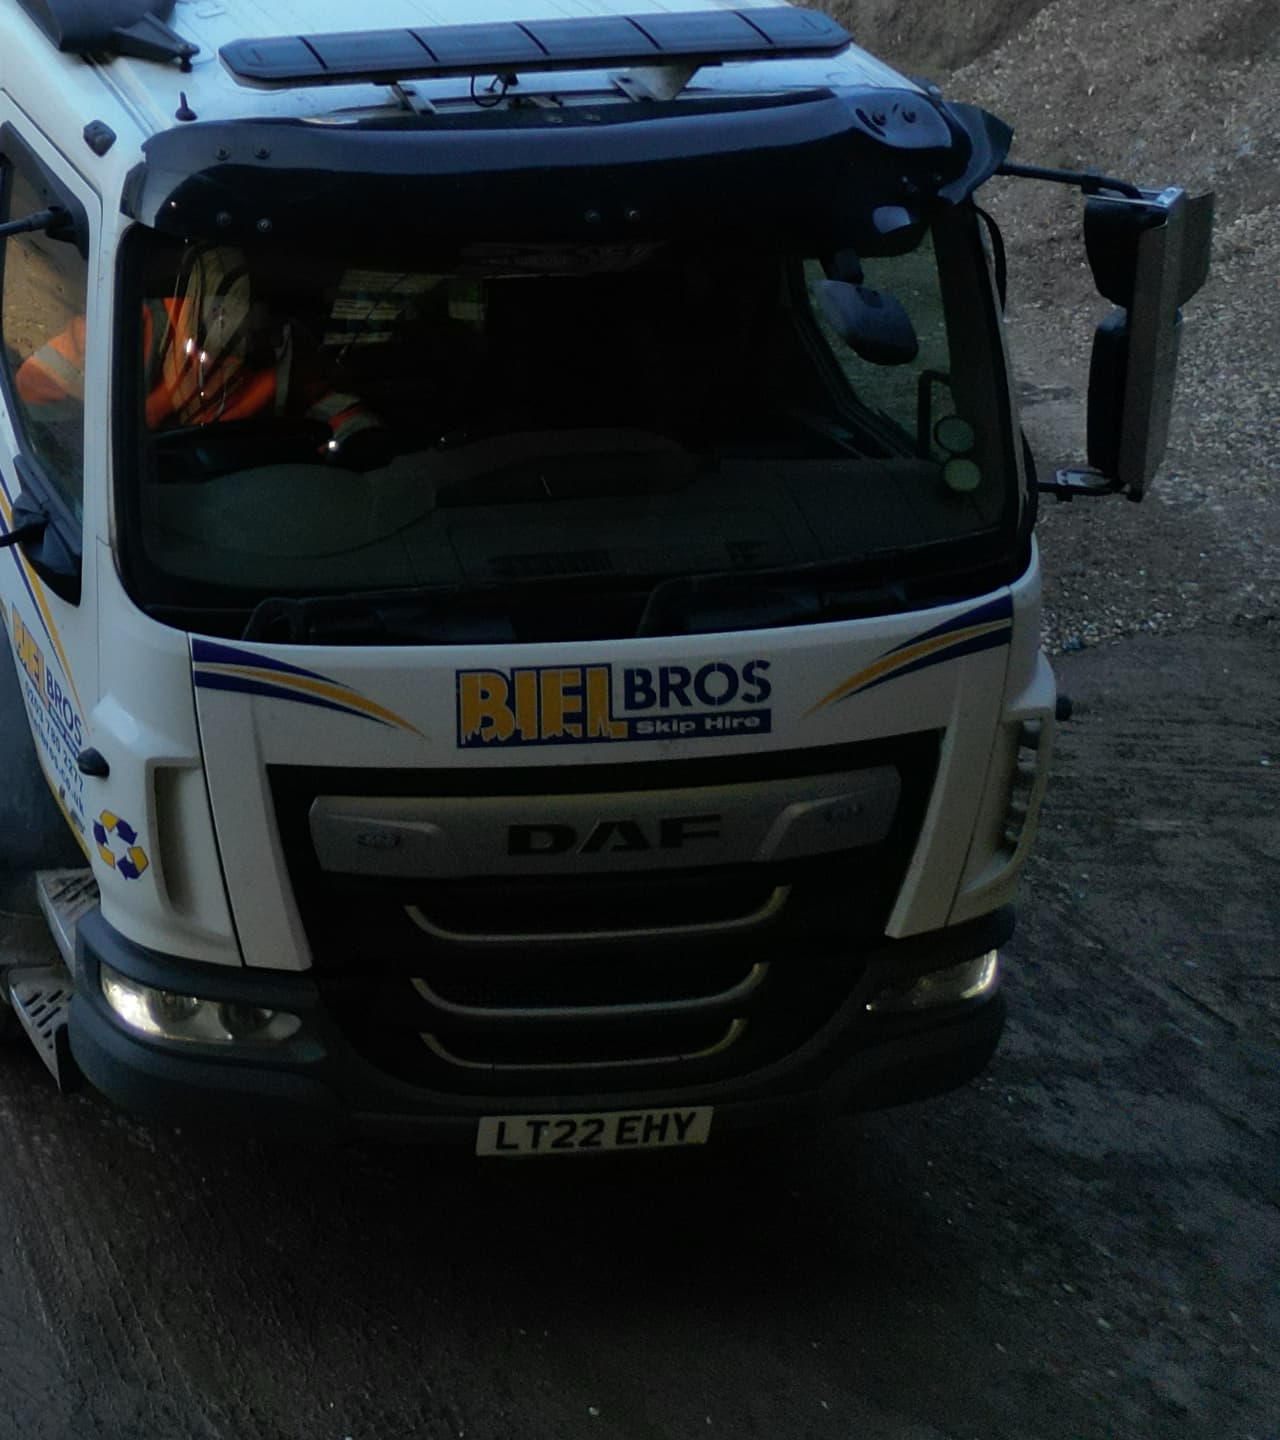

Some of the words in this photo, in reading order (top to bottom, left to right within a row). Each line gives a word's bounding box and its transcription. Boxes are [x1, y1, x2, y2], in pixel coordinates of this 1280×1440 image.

[46, 664, 83, 747] BROS
[458, 666, 628, 745] BIEL
[623, 659, 772, 710] BROS
[635, 718, 696, 736] Skip
[704, 714, 761, 731] Hire
[507, 814, 722, 857] DAF
[495, 1118, 606, 1151] LT22
[615, 1112, 697, 1145] EHY
